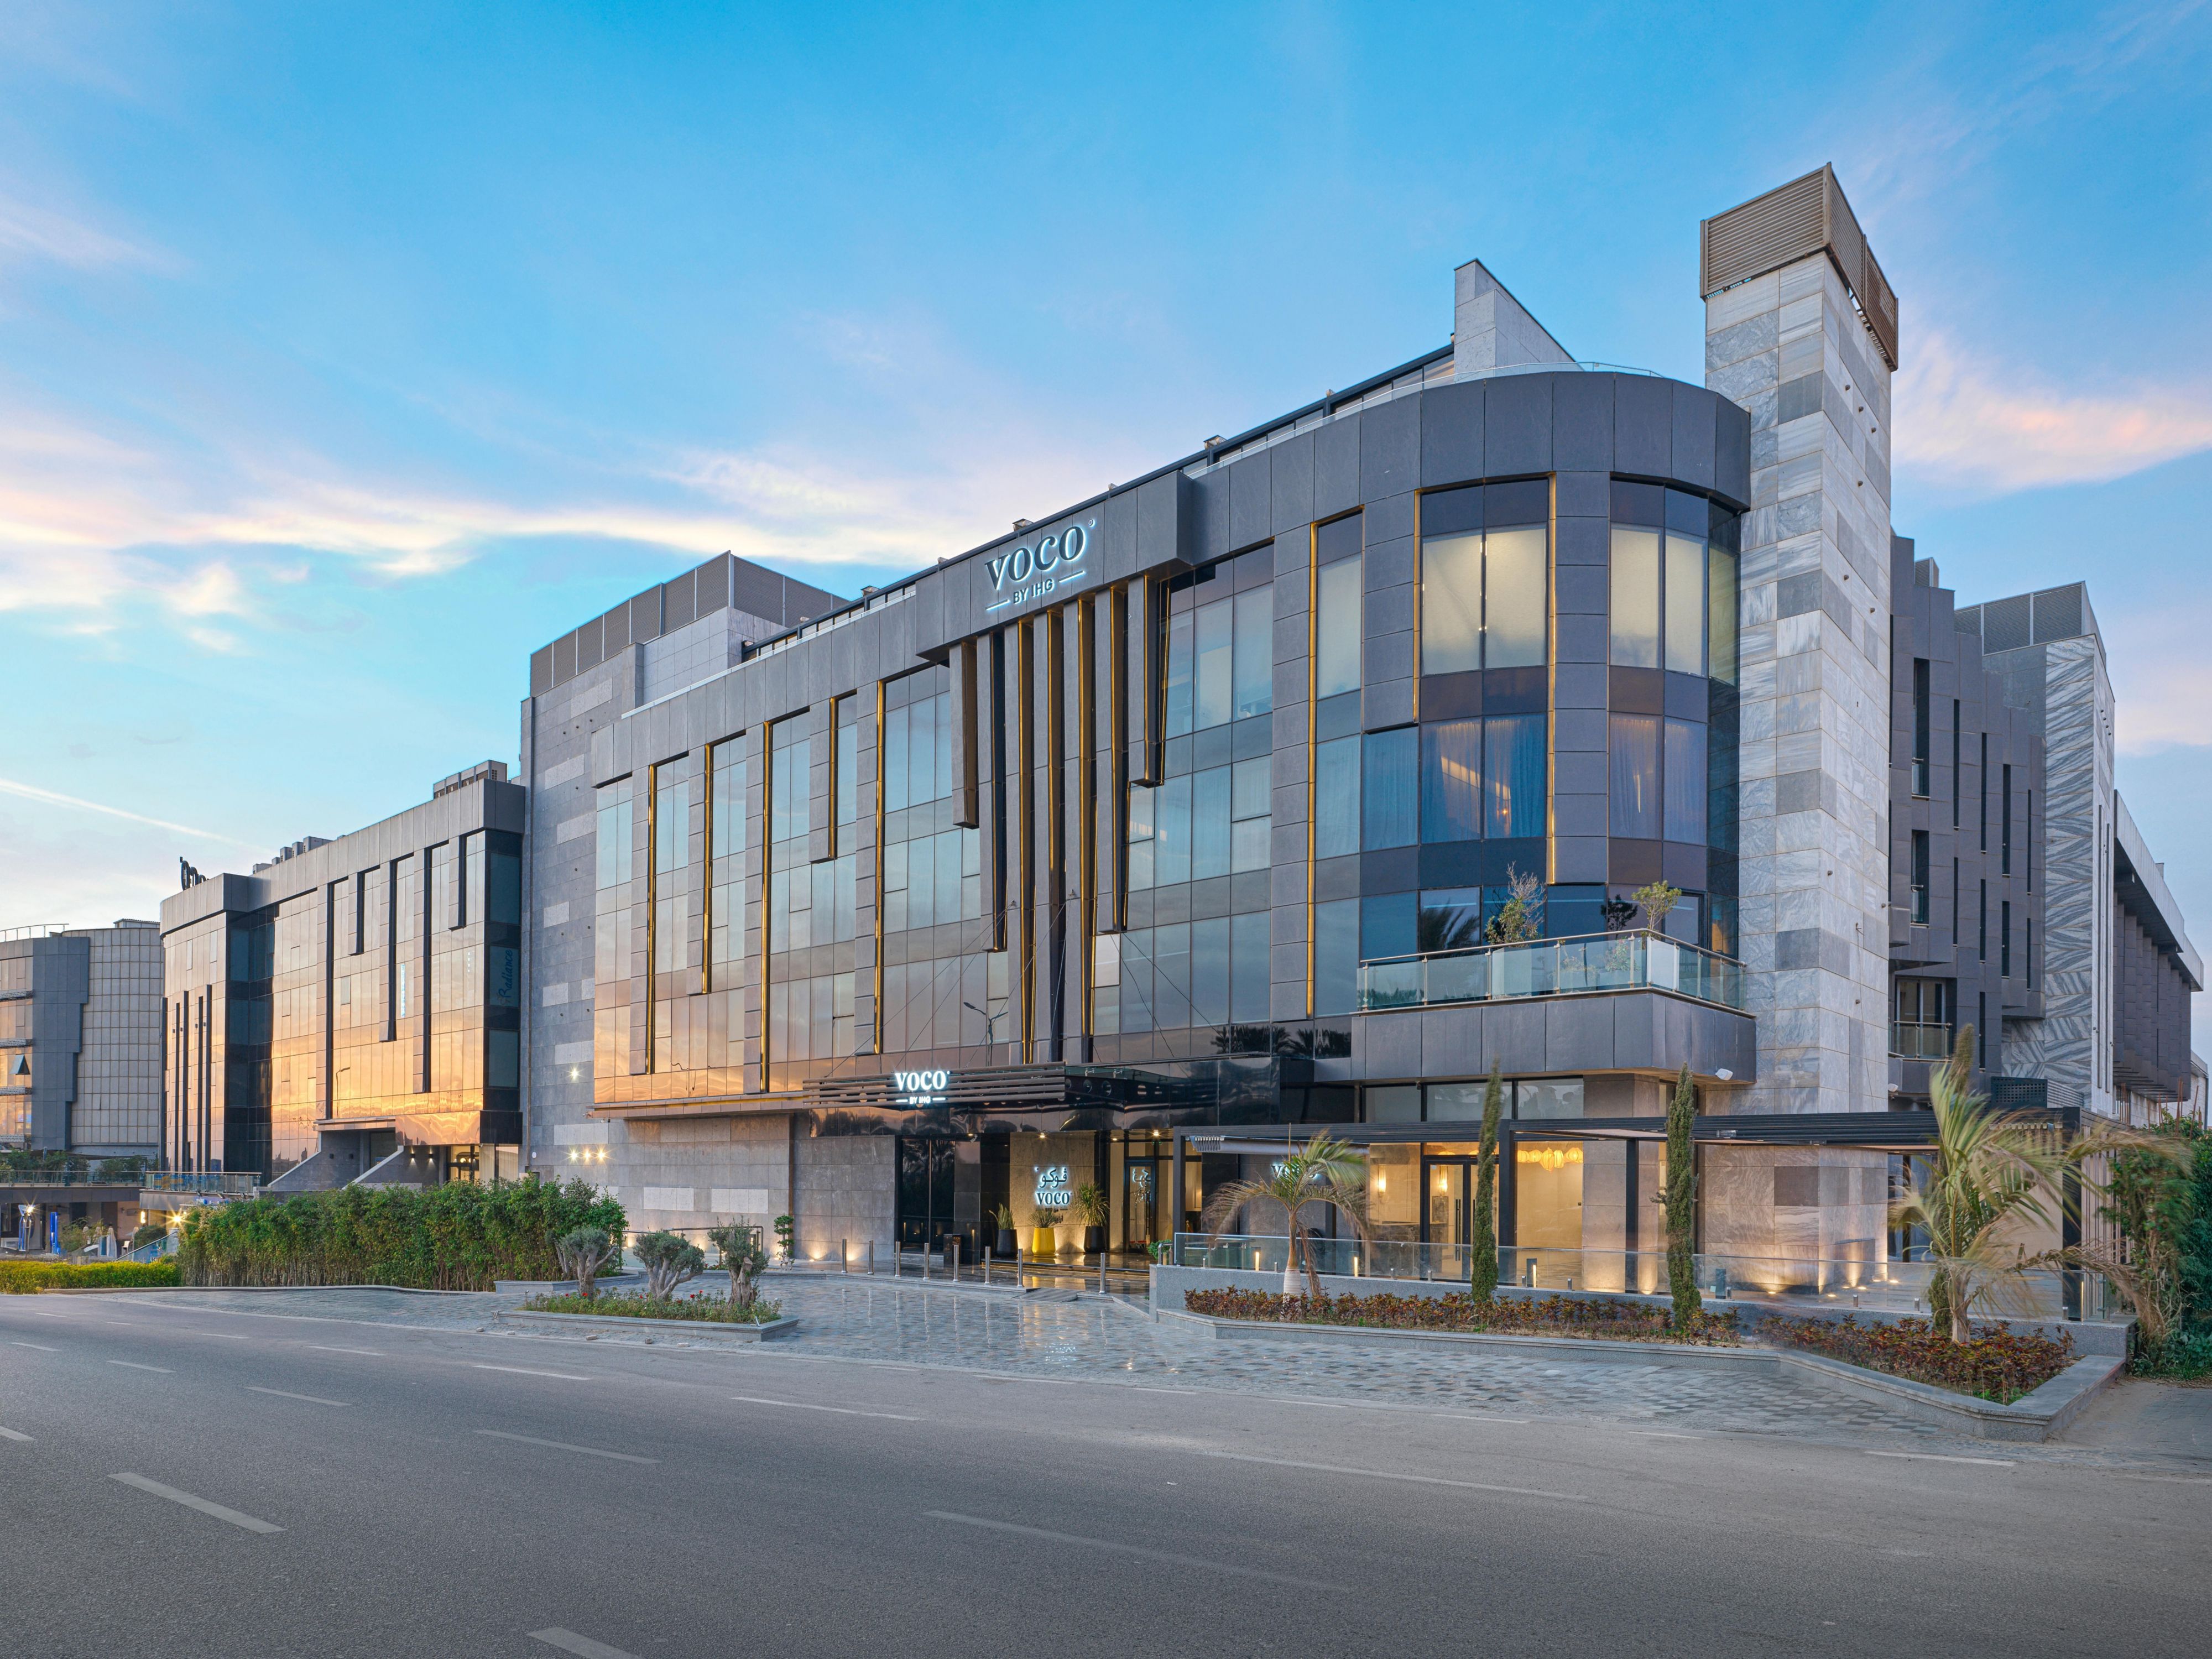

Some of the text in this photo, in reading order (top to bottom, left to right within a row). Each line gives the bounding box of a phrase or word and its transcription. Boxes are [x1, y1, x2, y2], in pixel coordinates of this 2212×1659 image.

[1013, 578, 1054, 604] BY IHG
[498, 950, 513, 998] Radiance
